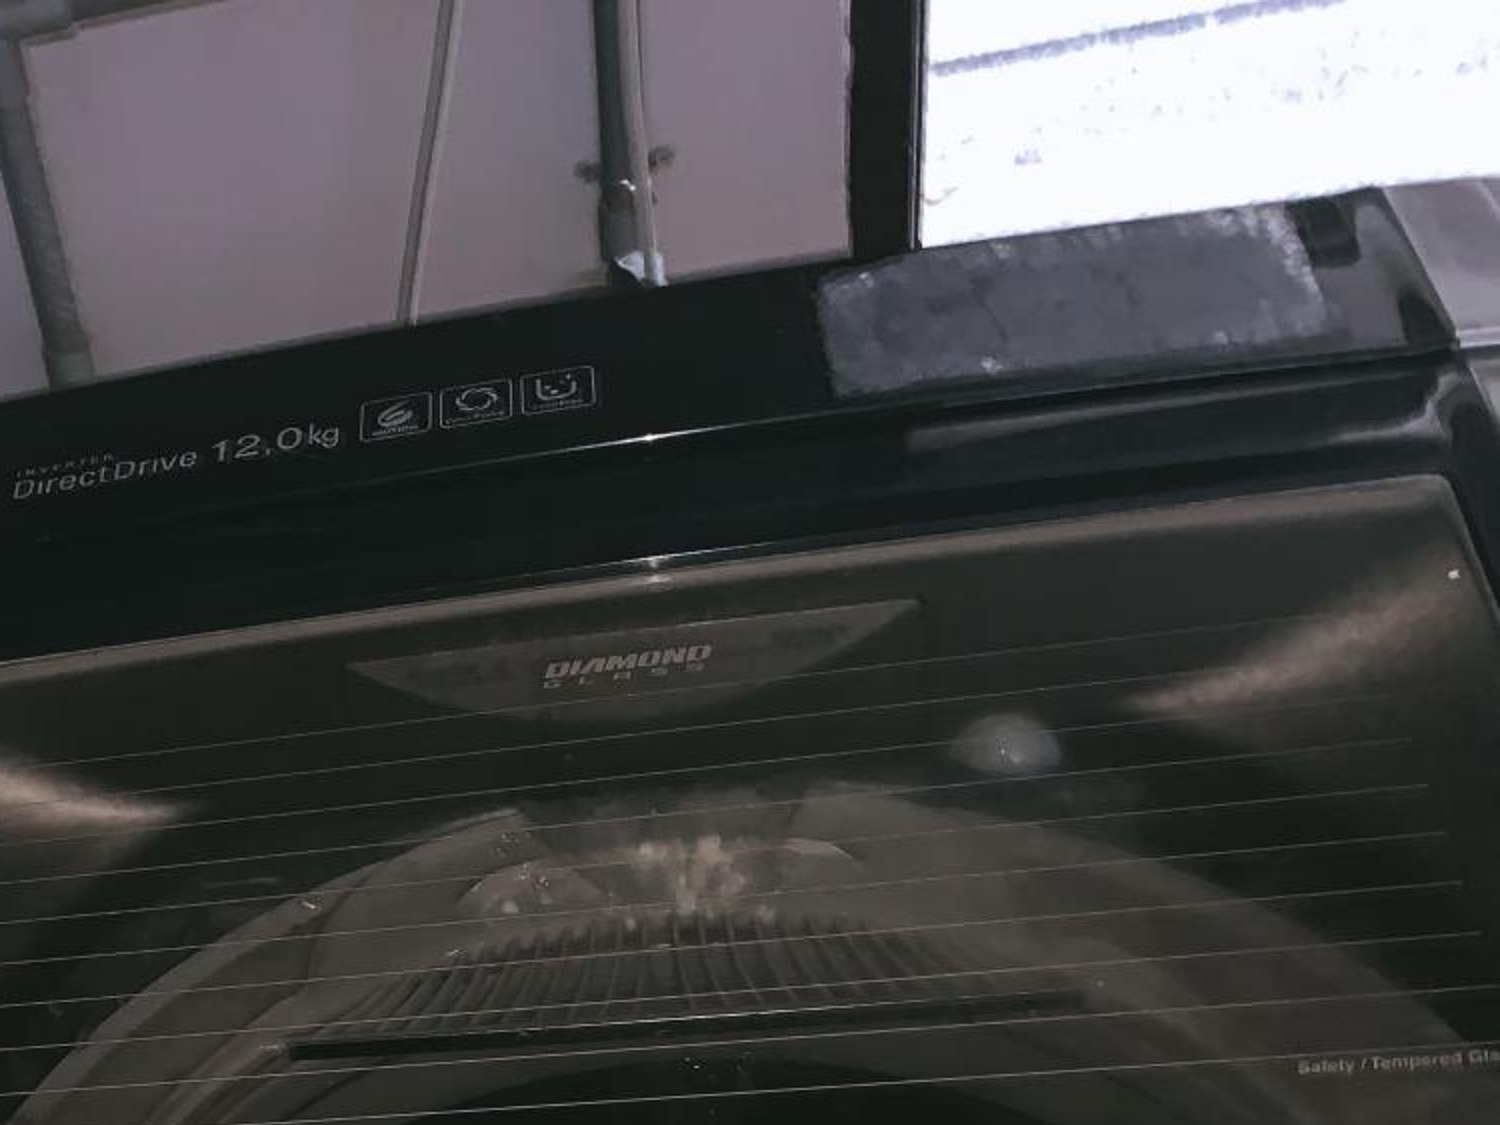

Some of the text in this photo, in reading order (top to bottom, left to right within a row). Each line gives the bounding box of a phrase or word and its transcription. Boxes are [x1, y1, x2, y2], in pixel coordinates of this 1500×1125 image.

[545, 644, 713, 679] DIAMOND
[1297, 1059, 1355, 1076] Safety
[1371, 1051, 1463, 1072] Tempered
